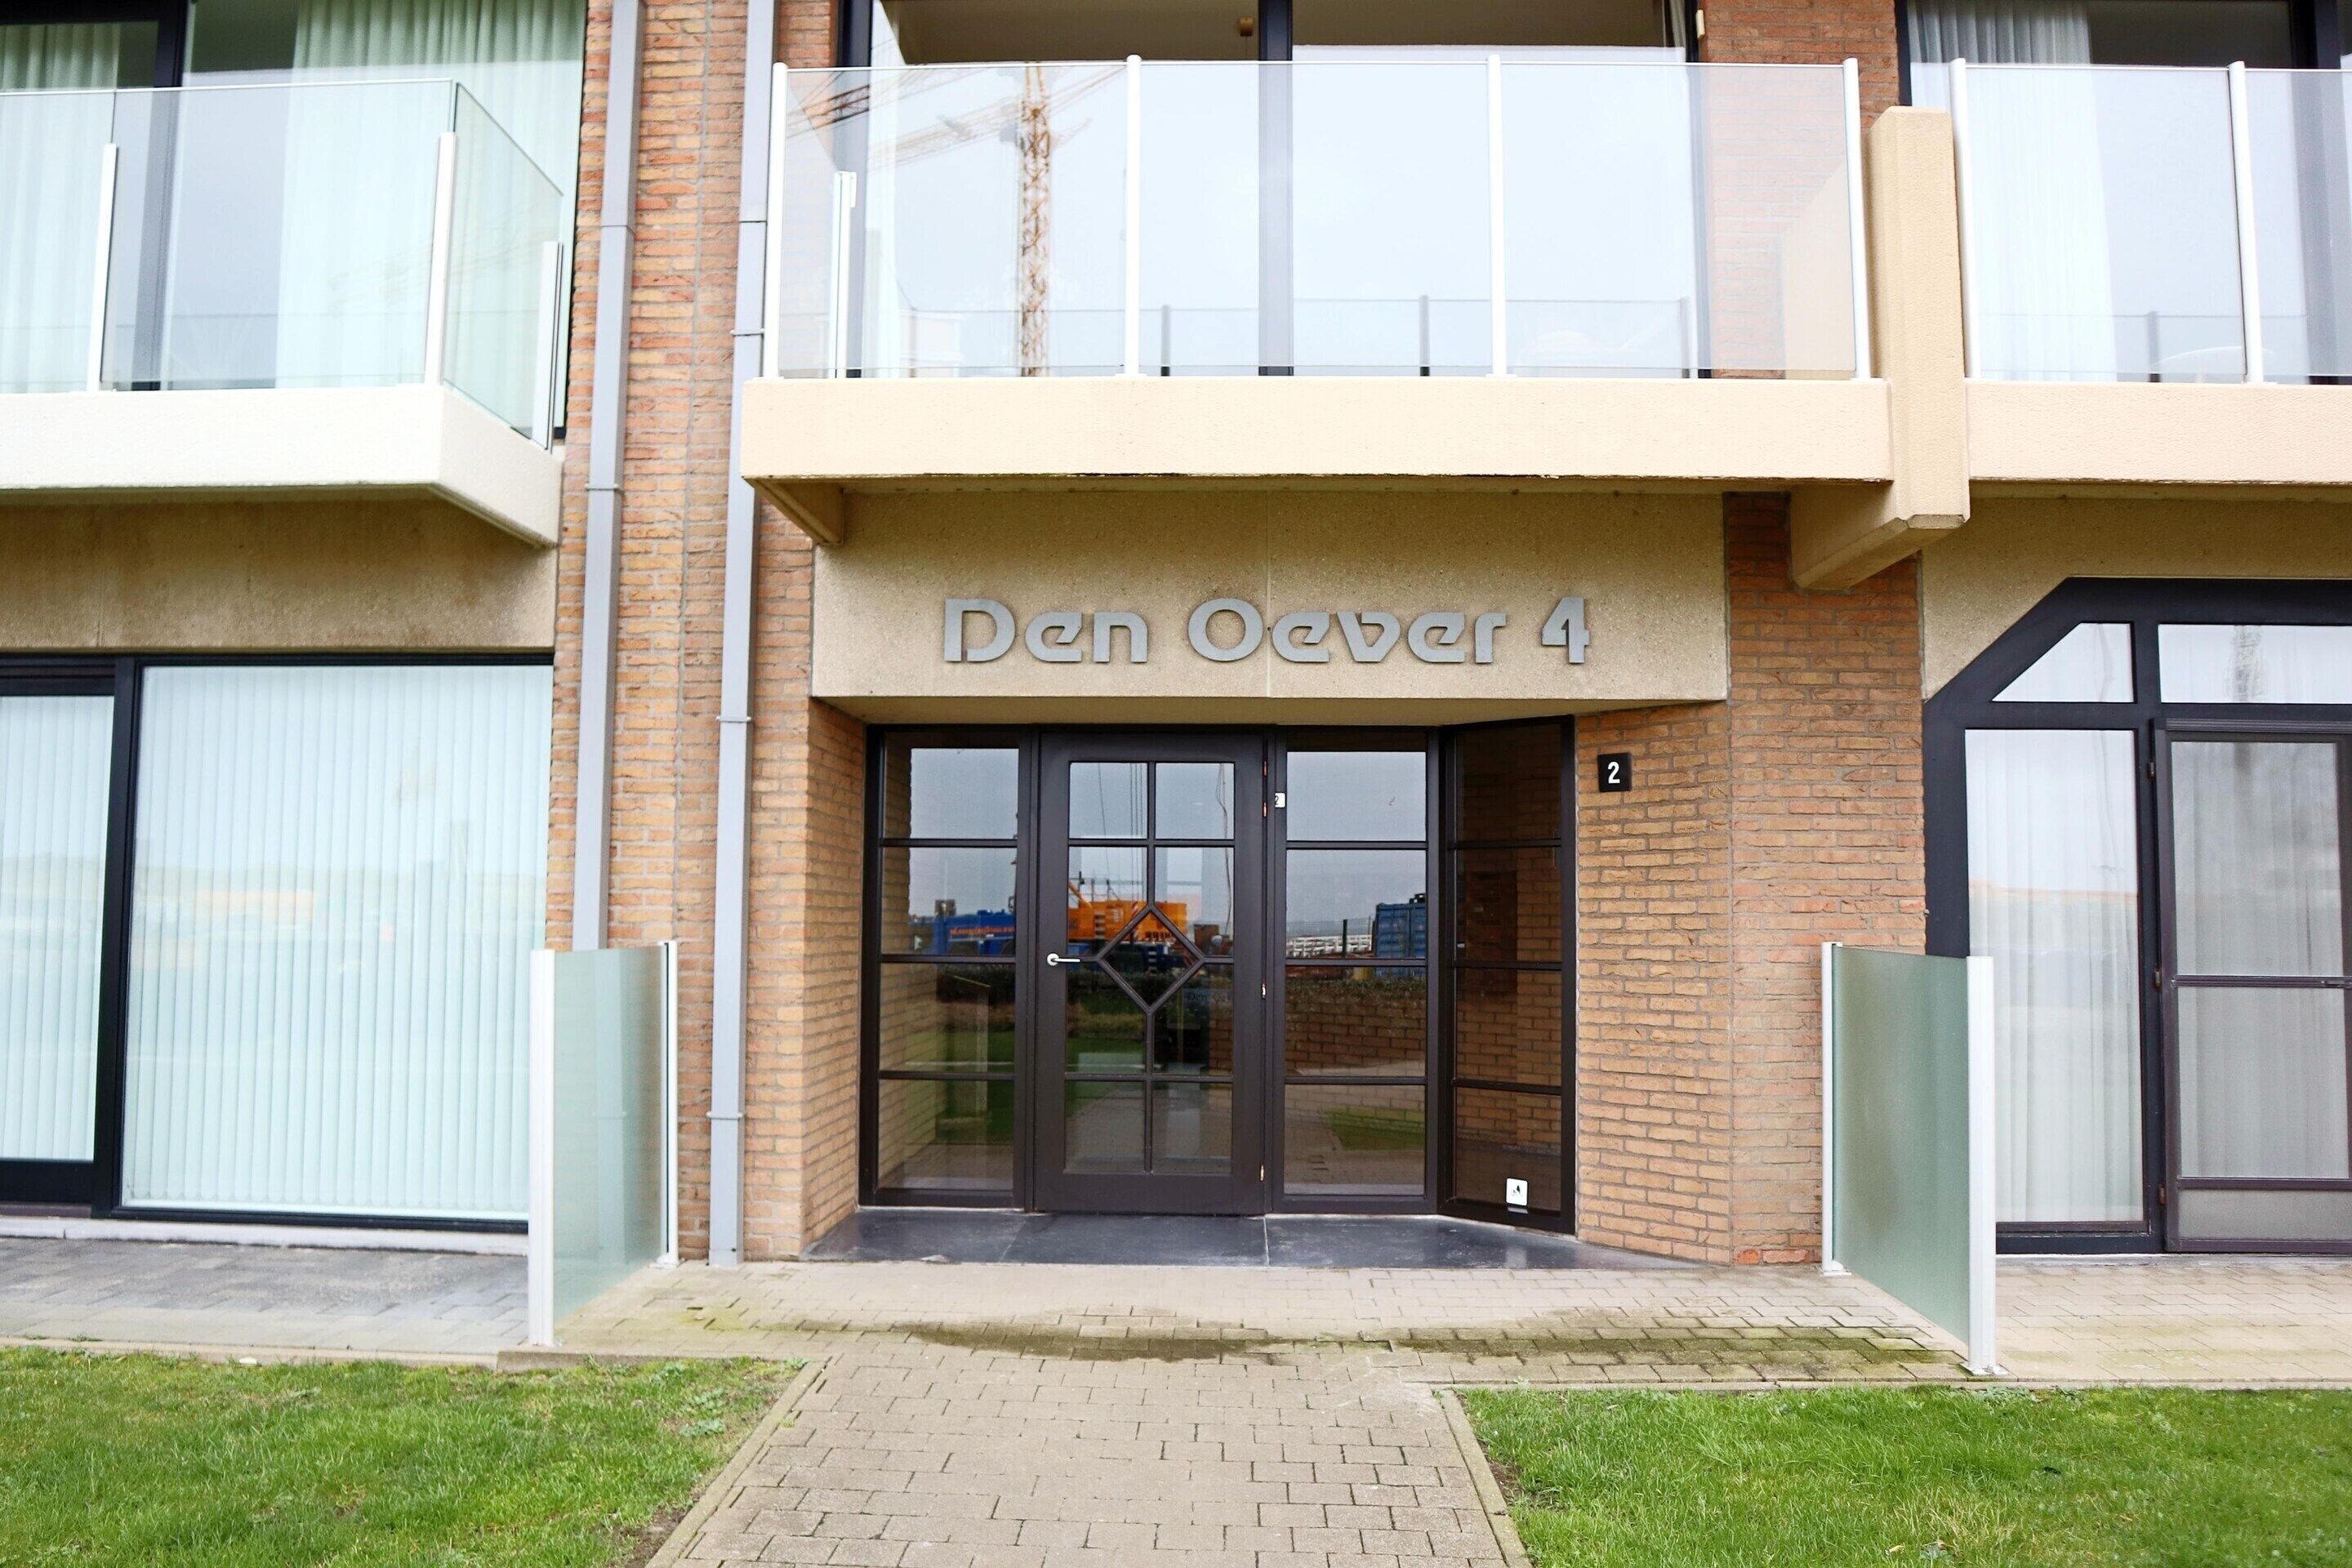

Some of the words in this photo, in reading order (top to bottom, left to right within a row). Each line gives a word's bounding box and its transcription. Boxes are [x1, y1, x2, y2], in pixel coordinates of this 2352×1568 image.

[944, 598, 1148, 663] Den
[1187, 598, 1507, 663] Oever
[1542, 596, 1590, 663] 4
[1607, 761, 1620, 784] 2
